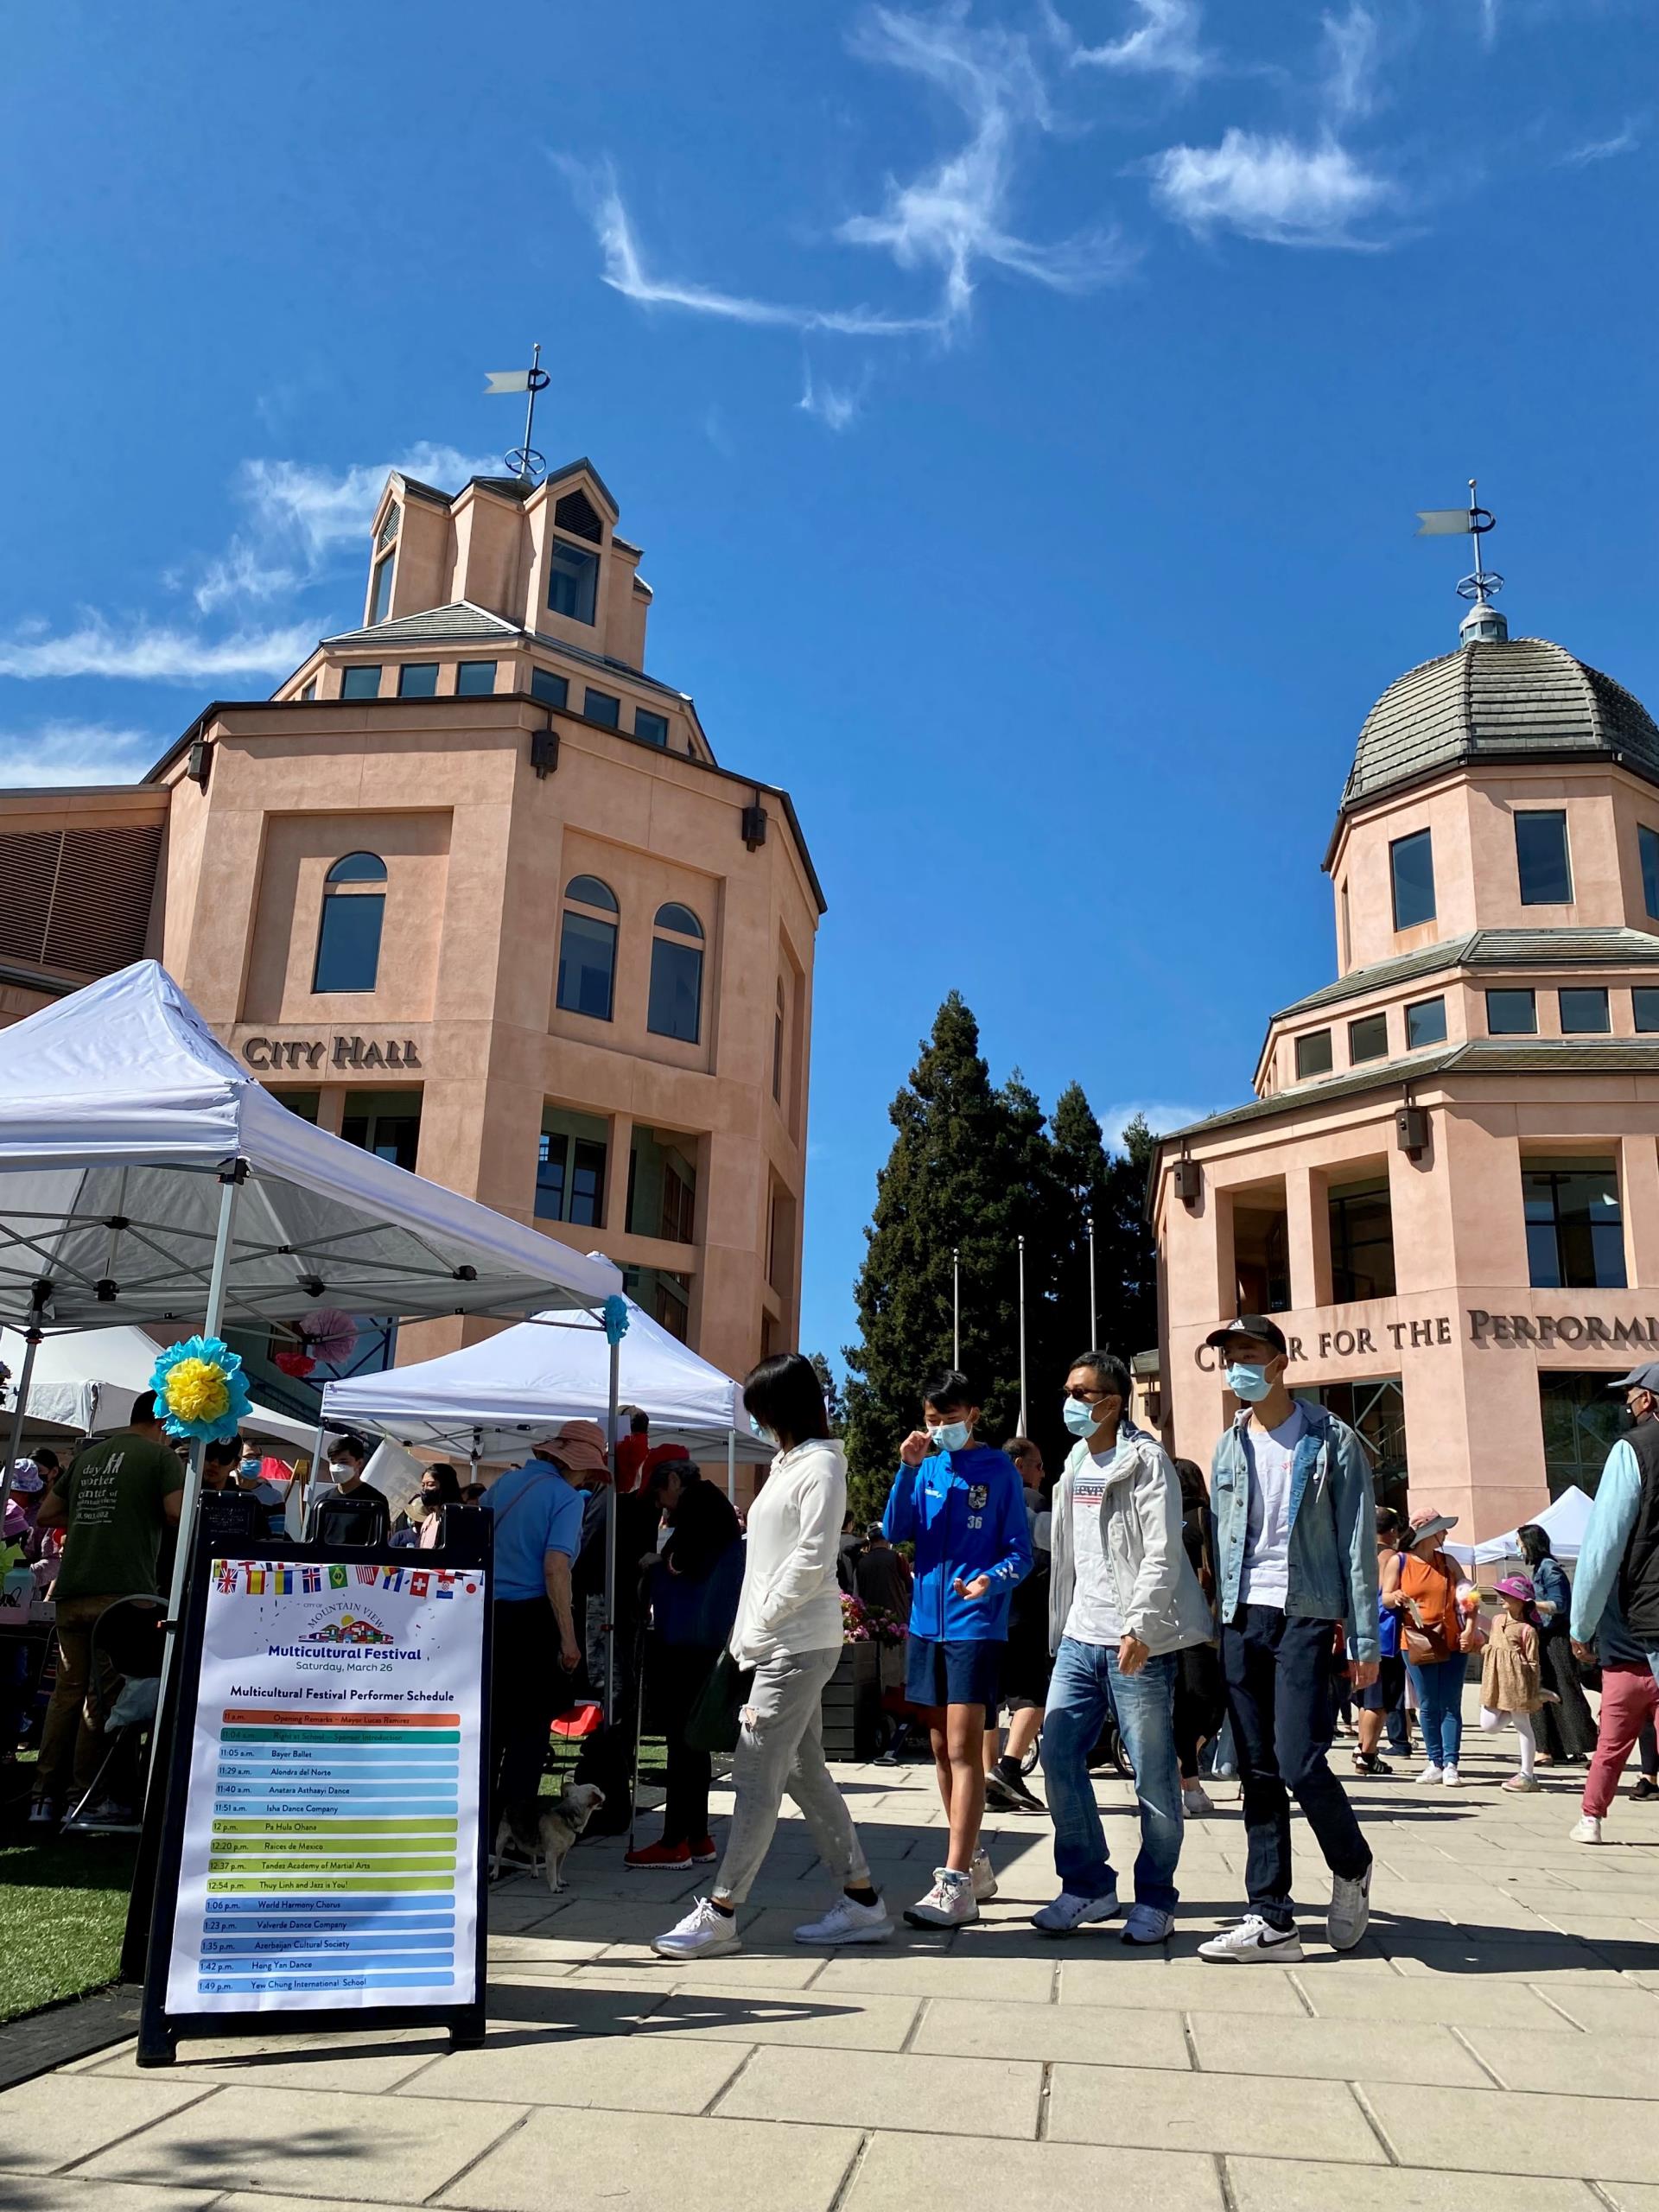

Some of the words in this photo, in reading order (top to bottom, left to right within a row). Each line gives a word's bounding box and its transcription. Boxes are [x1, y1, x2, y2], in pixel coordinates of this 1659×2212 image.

[244, 1037, 324, 1068] CITY
[331, 1037, 421, 1068] HALL
[1319, 1327, 1376, 1358] FOR
[1387, 1317, 1452, 1349] THE
[82, 1465, 101, 1476] day
[967, 1515, 982, 1529] 36
[308, 1601, 361, 1629] MOUNTAIN
[362, 1606, 385, 1629] VIEW
[268, 1644, 361, 1659] Multicultural
[364, 1648, 422, 1660] Festival
[296, 1661, 345, 1673] Saturday,
[346, 1662, 378, 1672] March
[379, 1663, 393, 1672] 26
[230, 1685, 303, 1699] Multicultural
[305, 1688, 346, 1700] Festival
[350, 1689, 404, 1700] Performer
[406, 1690, 454, 1701] Schedule
[273, 1713, 302, 1725] Opening
[340, 1716, 362, 1725] Mayor
[384, 1716, 410, 1725] Ramirez
[271, 1750, 291, 1759] Bayer
[311, 1768, 332, 1777] Norte
[306, 1804, 339, 1815] Company
[294, 1822, 317, 1831] Ohana
[230, 1863, 246, 1872] p.m.
[287, 1861, 320, 1871] Academy
[208, 1881, 228, 1890] 12:54
[230, 1883, 246, 1891] p.m.
[259, 1881, 277, 1891] Thuy
[278, 1880, 294, 1889] Linh
[296, 1880, 308, 1889] and
[310, 1880, 324, 1889] Jazz
[325, 1880, 331, 1889] is
[332, 1880, 348, 1889] You!
[225, 1903, 240, 1912] p.m.
[257, 1900, 279, 1909] World
[281, 1900, 315, 1910] Harmony
[315, 1900, 340, 1909] Chorus
[205, 1921, 220, 1929] 1:23
[221, 1923, 238, 1932] p.m.
[257, 1921, 288, 1929] Valverde
[289, 1920, 312, 1929] Dance
[314, 1920, 347, 1930] Company
[202, 1942, 217, 1950] 1:35
[219, 1943, 235, 1953] p.m.
[254, 1941, 292, 1951] Azerbaijan
[294, 1939, 322, 1948] Cultural
[324, 1939, 350, 1949] Society
[200, 1962, 216, 1971] 1:42
[218, 1964, 234, 1973] p.m.
[251, 1961, 271, 1971] Hong
[217, 1984, 233, 1993] p.m.
[268, 1980, 293, 1991] Chung
[295, 1979, 340, 1988] International
[342, 1978, 366, 1986] School
